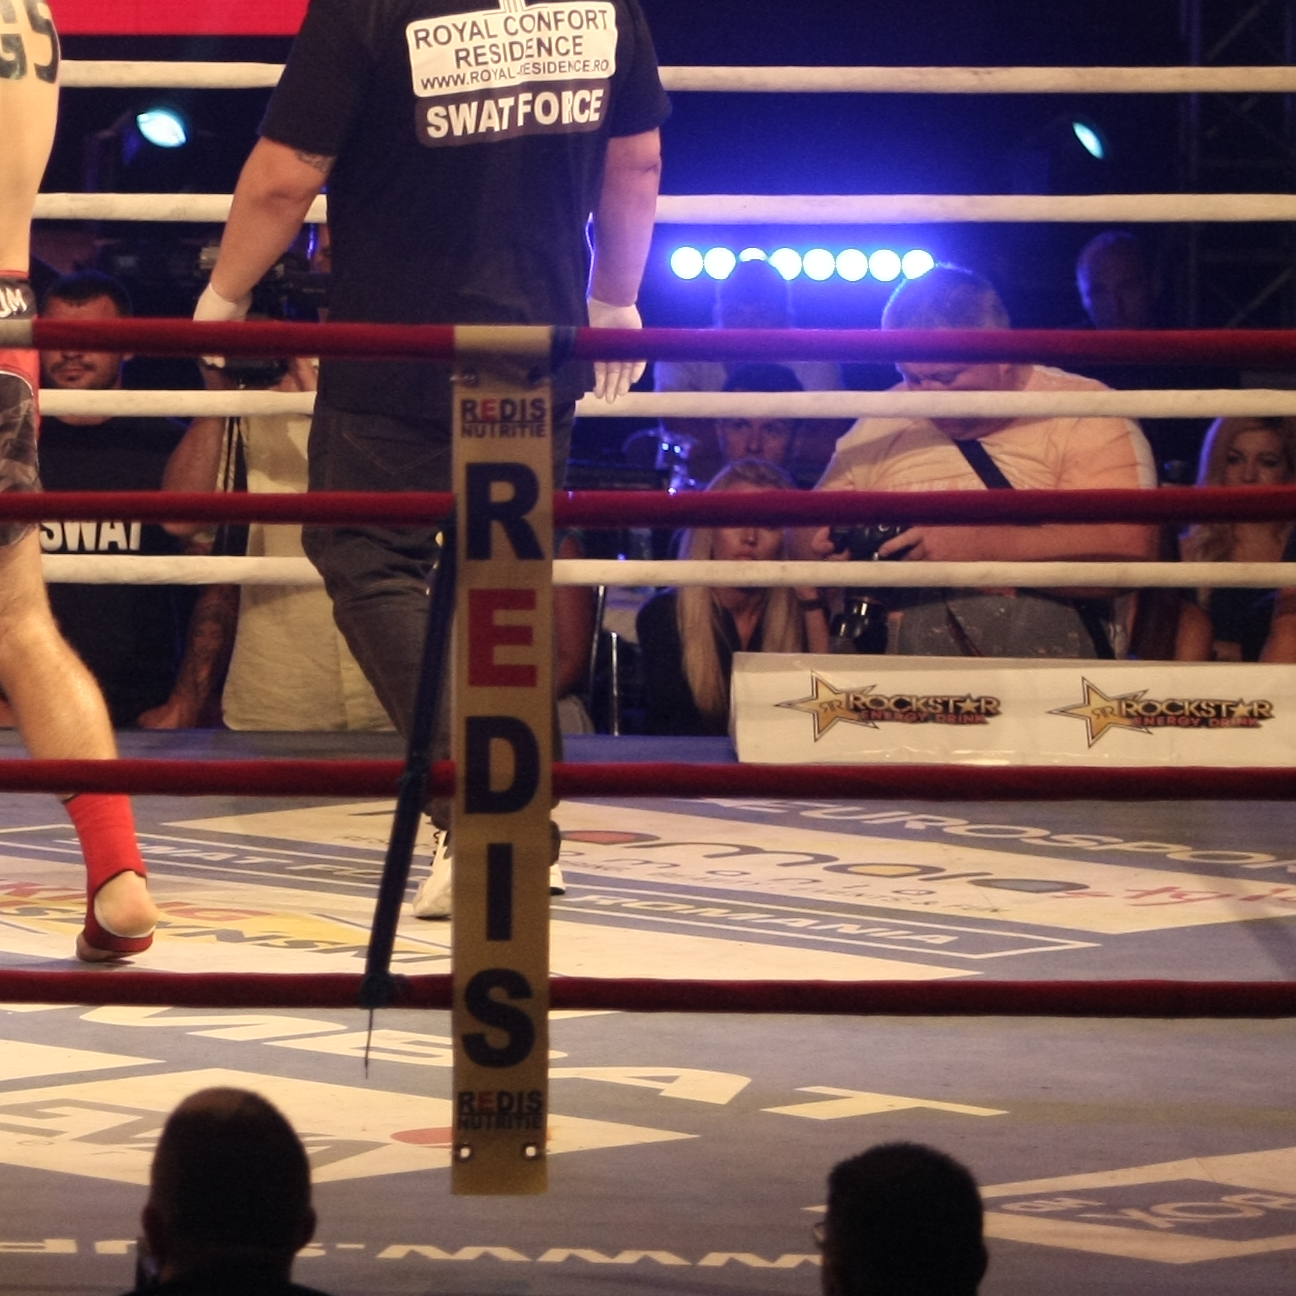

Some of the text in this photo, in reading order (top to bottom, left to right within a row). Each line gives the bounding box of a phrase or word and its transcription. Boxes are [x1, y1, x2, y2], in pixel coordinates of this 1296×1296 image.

[413, 9, 608, 50] ROYAL CONFORT
[454, 35, 584, 69] RESIDENCE
[461, 398, 547, 422] REDIS
[461, 423, 547, 439] NUTRITIE
[861, 710, 987, 724] ENERGY DRINK
[1132, 715, 1259, 729] ENERGY DRINK
[726, 798, 1296, 874] EUROSPOR
[54, 837, 293, 864] WAT
[561, 894, 962, 946] ROMANIA
[458, 1091, 544, 1116] REDIS
[458, 1116, 544, 1132] NUTRITIE
